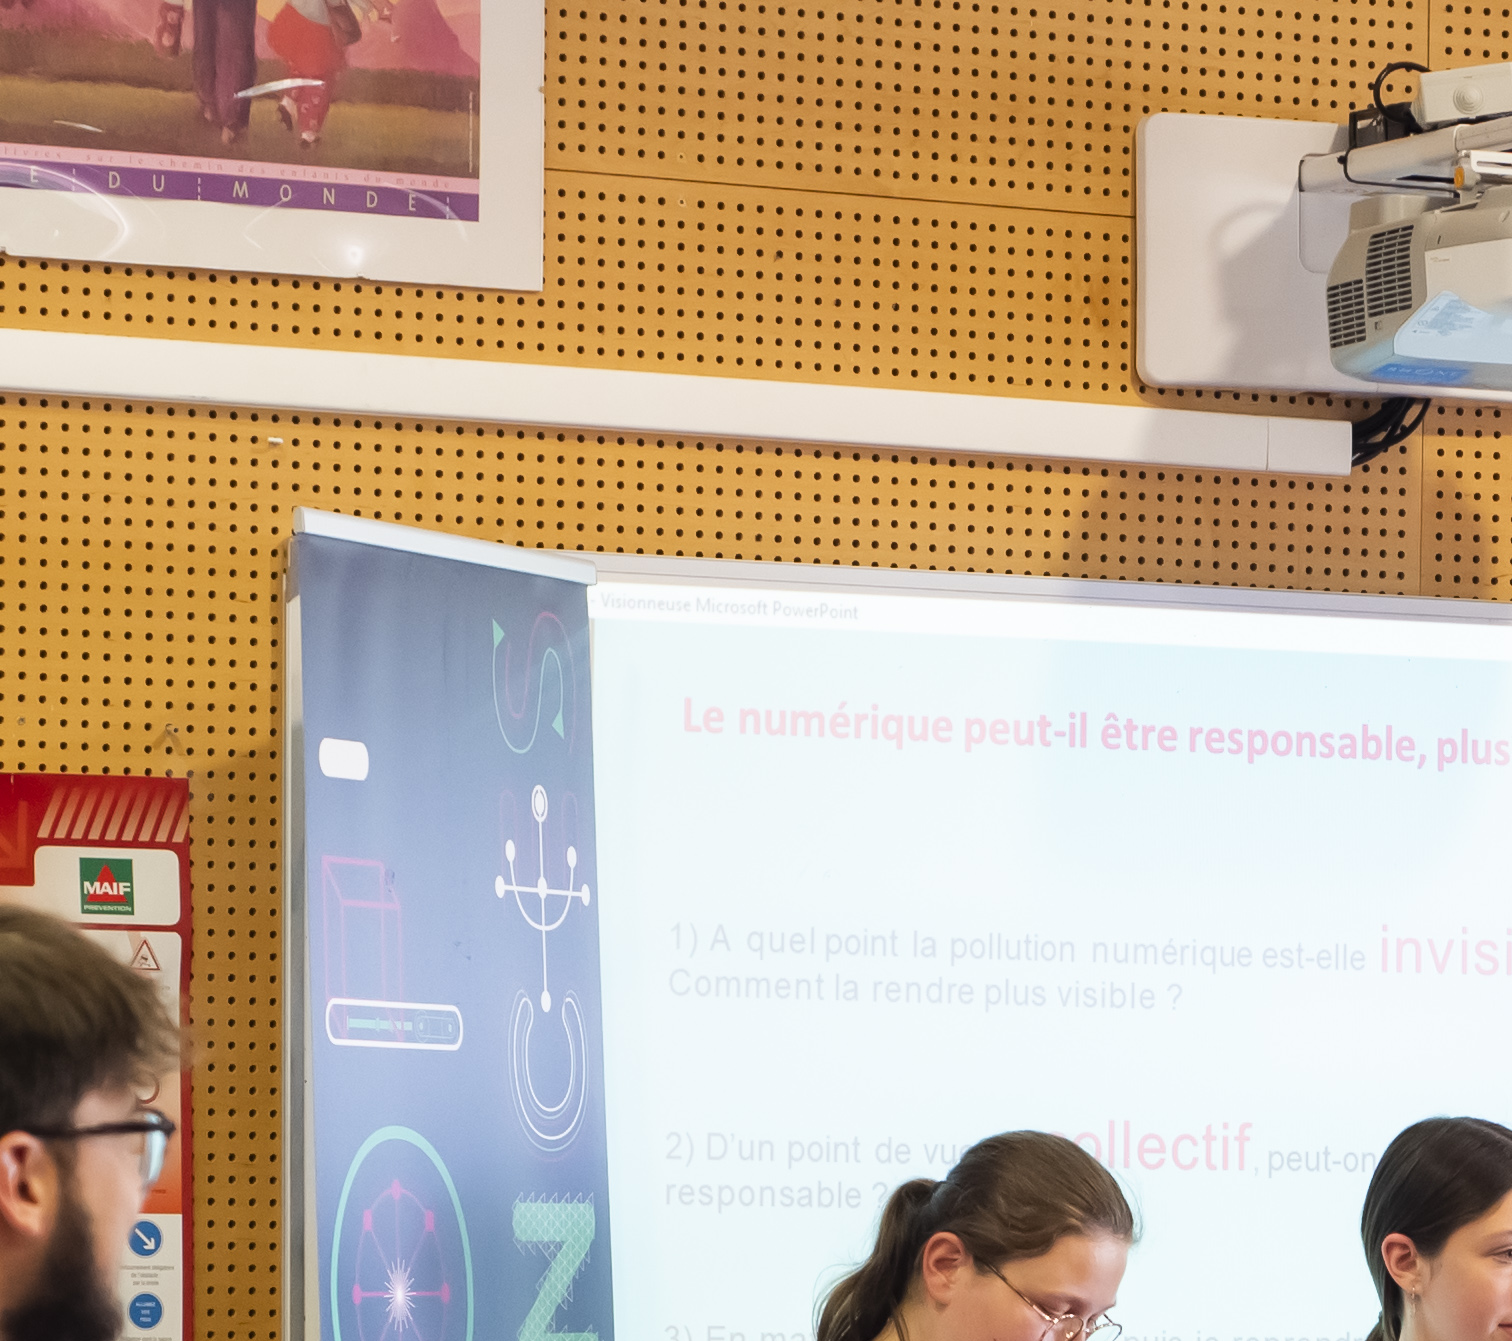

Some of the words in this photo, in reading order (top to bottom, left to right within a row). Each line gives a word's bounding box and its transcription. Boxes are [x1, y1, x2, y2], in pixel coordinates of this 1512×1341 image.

[4, 145, 62, 160] livres
[87, 153, 114, 164] sur
[129, 153, 144, 165] le
[159, 157, 223, 172] chemin
[238, 162, 266, 175] des
[279, 166, 350, 182] enfants
[364, 172, 382, 184] du
[395, 175, 451, 190] monde
[108, 171, 166, 193] DU
[232, 180, 418, 212] MONDE
[601, 592, 692, 614] Visionneuse
[696, 596, 770, 618] Microsoft
[773, 599, 859, 622] PowerPoint
[684, 697, 725, 735] Le
[739, 701, 953, 751] numérique
[964, 709, 1087, 752] peut-il
[1100, 712, 1178, 751] être
[1189, 722, 1426, 770] responsable,
[1436, 727, 1510, 772] plus
[83, 881, 131, 896] MAIF
[670, 921, 699, 960] 1)
[708, 923, 731, 953] A
[746, 926, 816, 961] quel
[825, 928, 899, 963] point
[912, 930, 938, 959] la
[950, 931, 1075, 966] pollution
[1091, 936, 1254, 976] numérique
[1261, 944, 1366, 971] est-elle
[668, 967, 832, 1001] Comment
[835, 973, 859, 1001] la
[872, 974, 975, 1005] rendre
[985, 978, 1048, 1013] plus
[1057, 980, 1157, 1010] visible
[1166, 982, 1183, 1011] ?
[665, 1131, 695, 1168] 2)
[707, 1132, 775, 1162] D'un
[788, 1135, 862, 1170] point
[874, 1135, 912, 1166] de
[1267, 1145, 1376, 1179] peut-on
[665, 1179, 861, 1214] responsable
